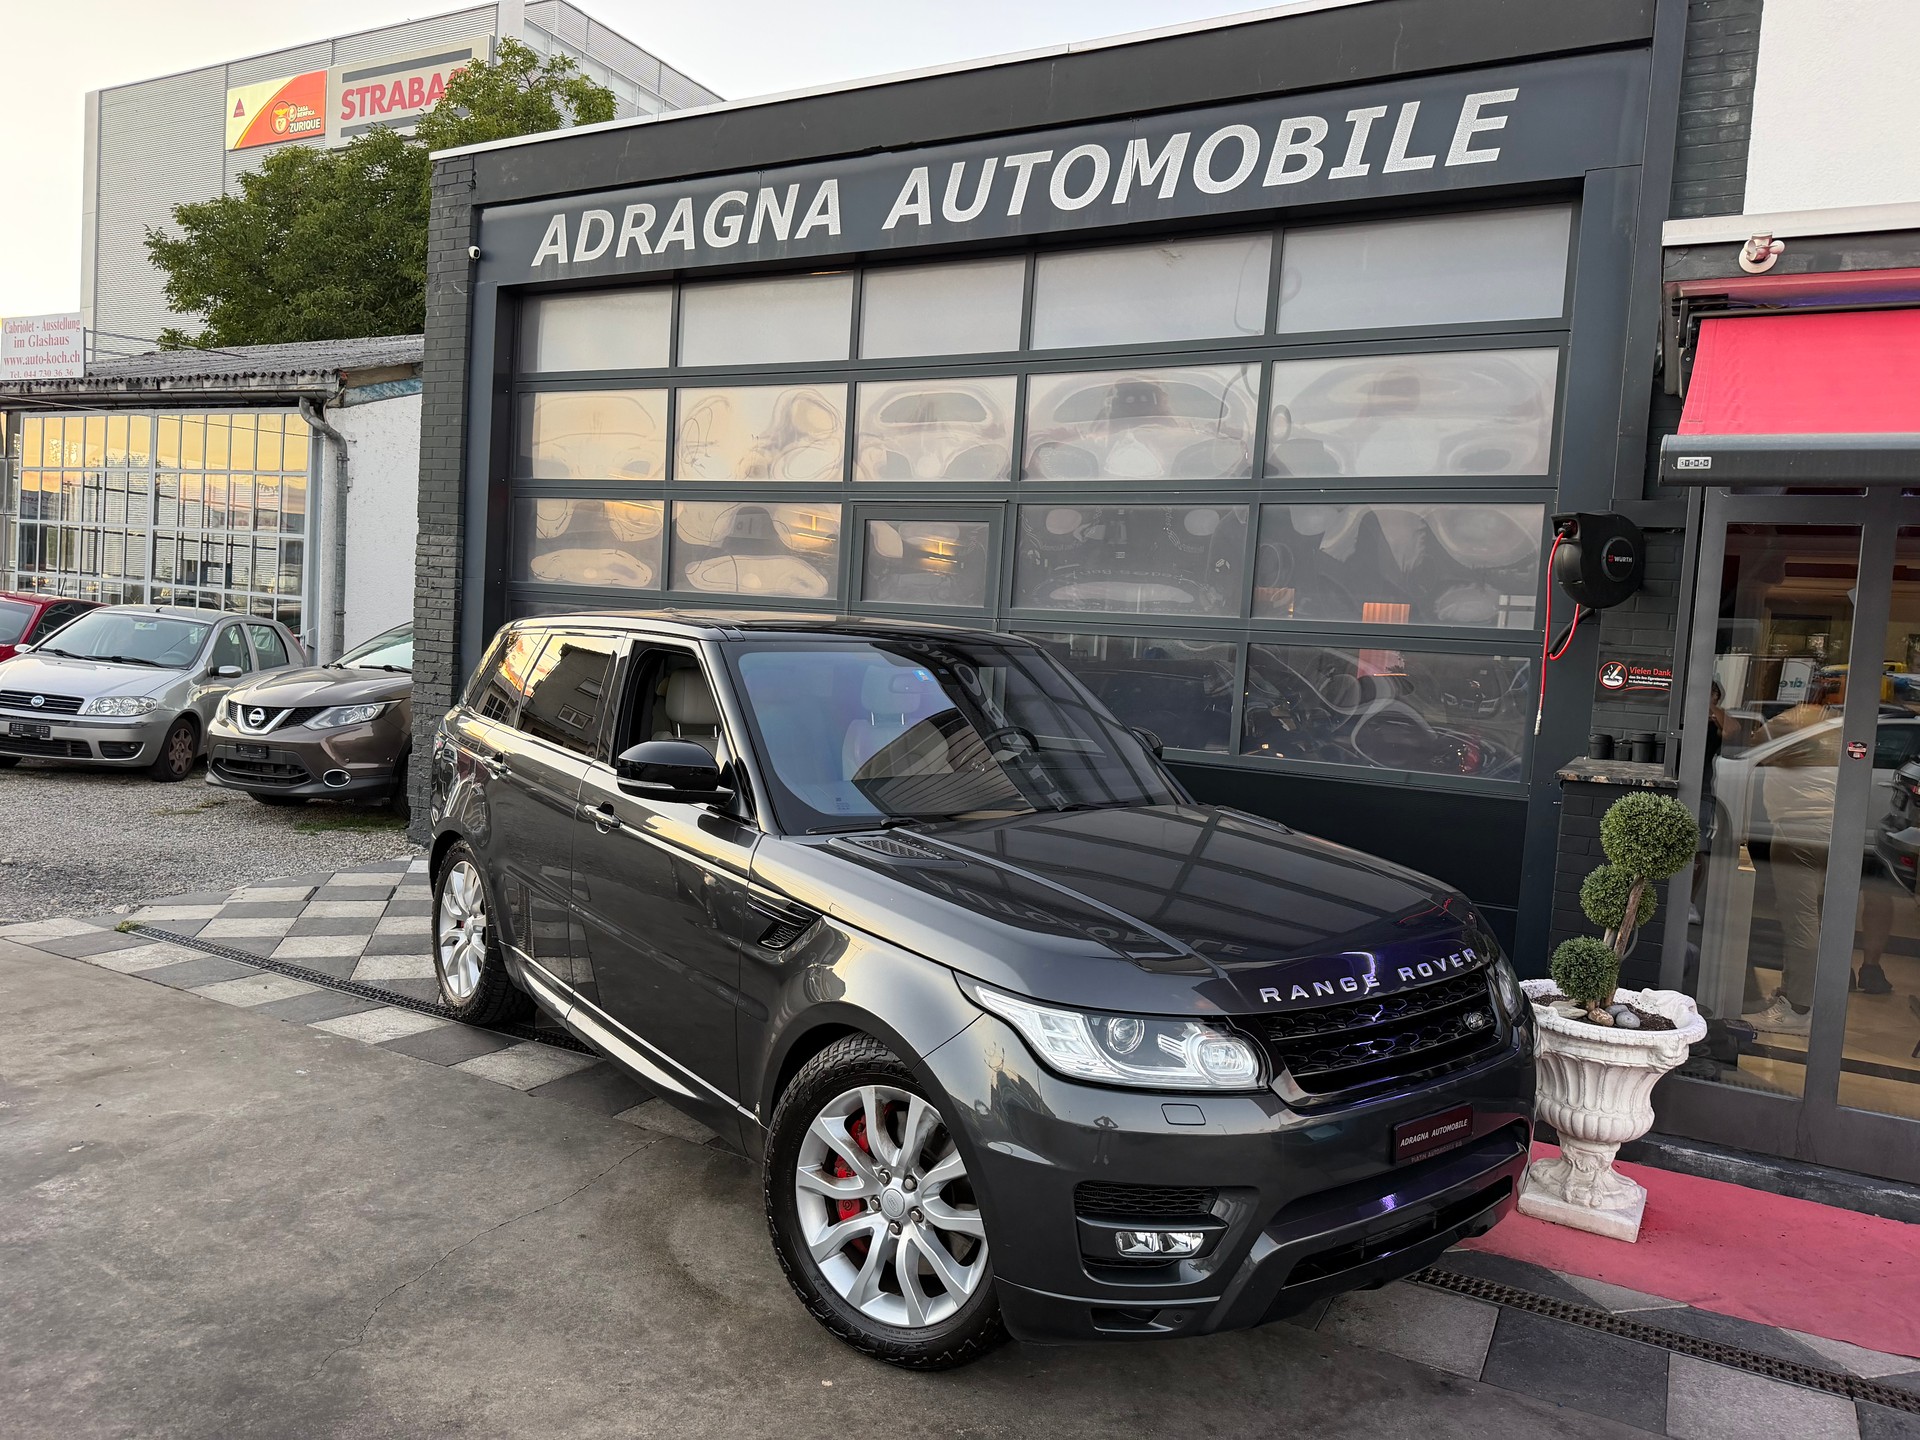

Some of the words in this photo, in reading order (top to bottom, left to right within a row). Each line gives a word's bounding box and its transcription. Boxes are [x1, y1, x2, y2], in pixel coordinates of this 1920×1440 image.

[289, 118, 321, 134] ZURIQUE
[531, 179, 841, 267] ADRAGNA
[881, 87, 1520, 230] AUTOMOBILE
[4, 320, 35, 335] Cabriolet
[41, 316, 81, 332] Ausstellung
[14, 336, 25, 348] im
[28, 334, 70, 348] Glashaus
[3, 350, 81, 366] www.auto-koch.ch
[23, 370, 37, 378] 044
[1629, 666, 1652, 676] Vielen
[1259, 973, 1381, 1004] RANGE
[1397, 947, 1478, 982] ROVER
[1400, 1131, 1429, 1148] ADRAGNA
[1431, 1118, 1468, 1138] AUTOMOBILE
